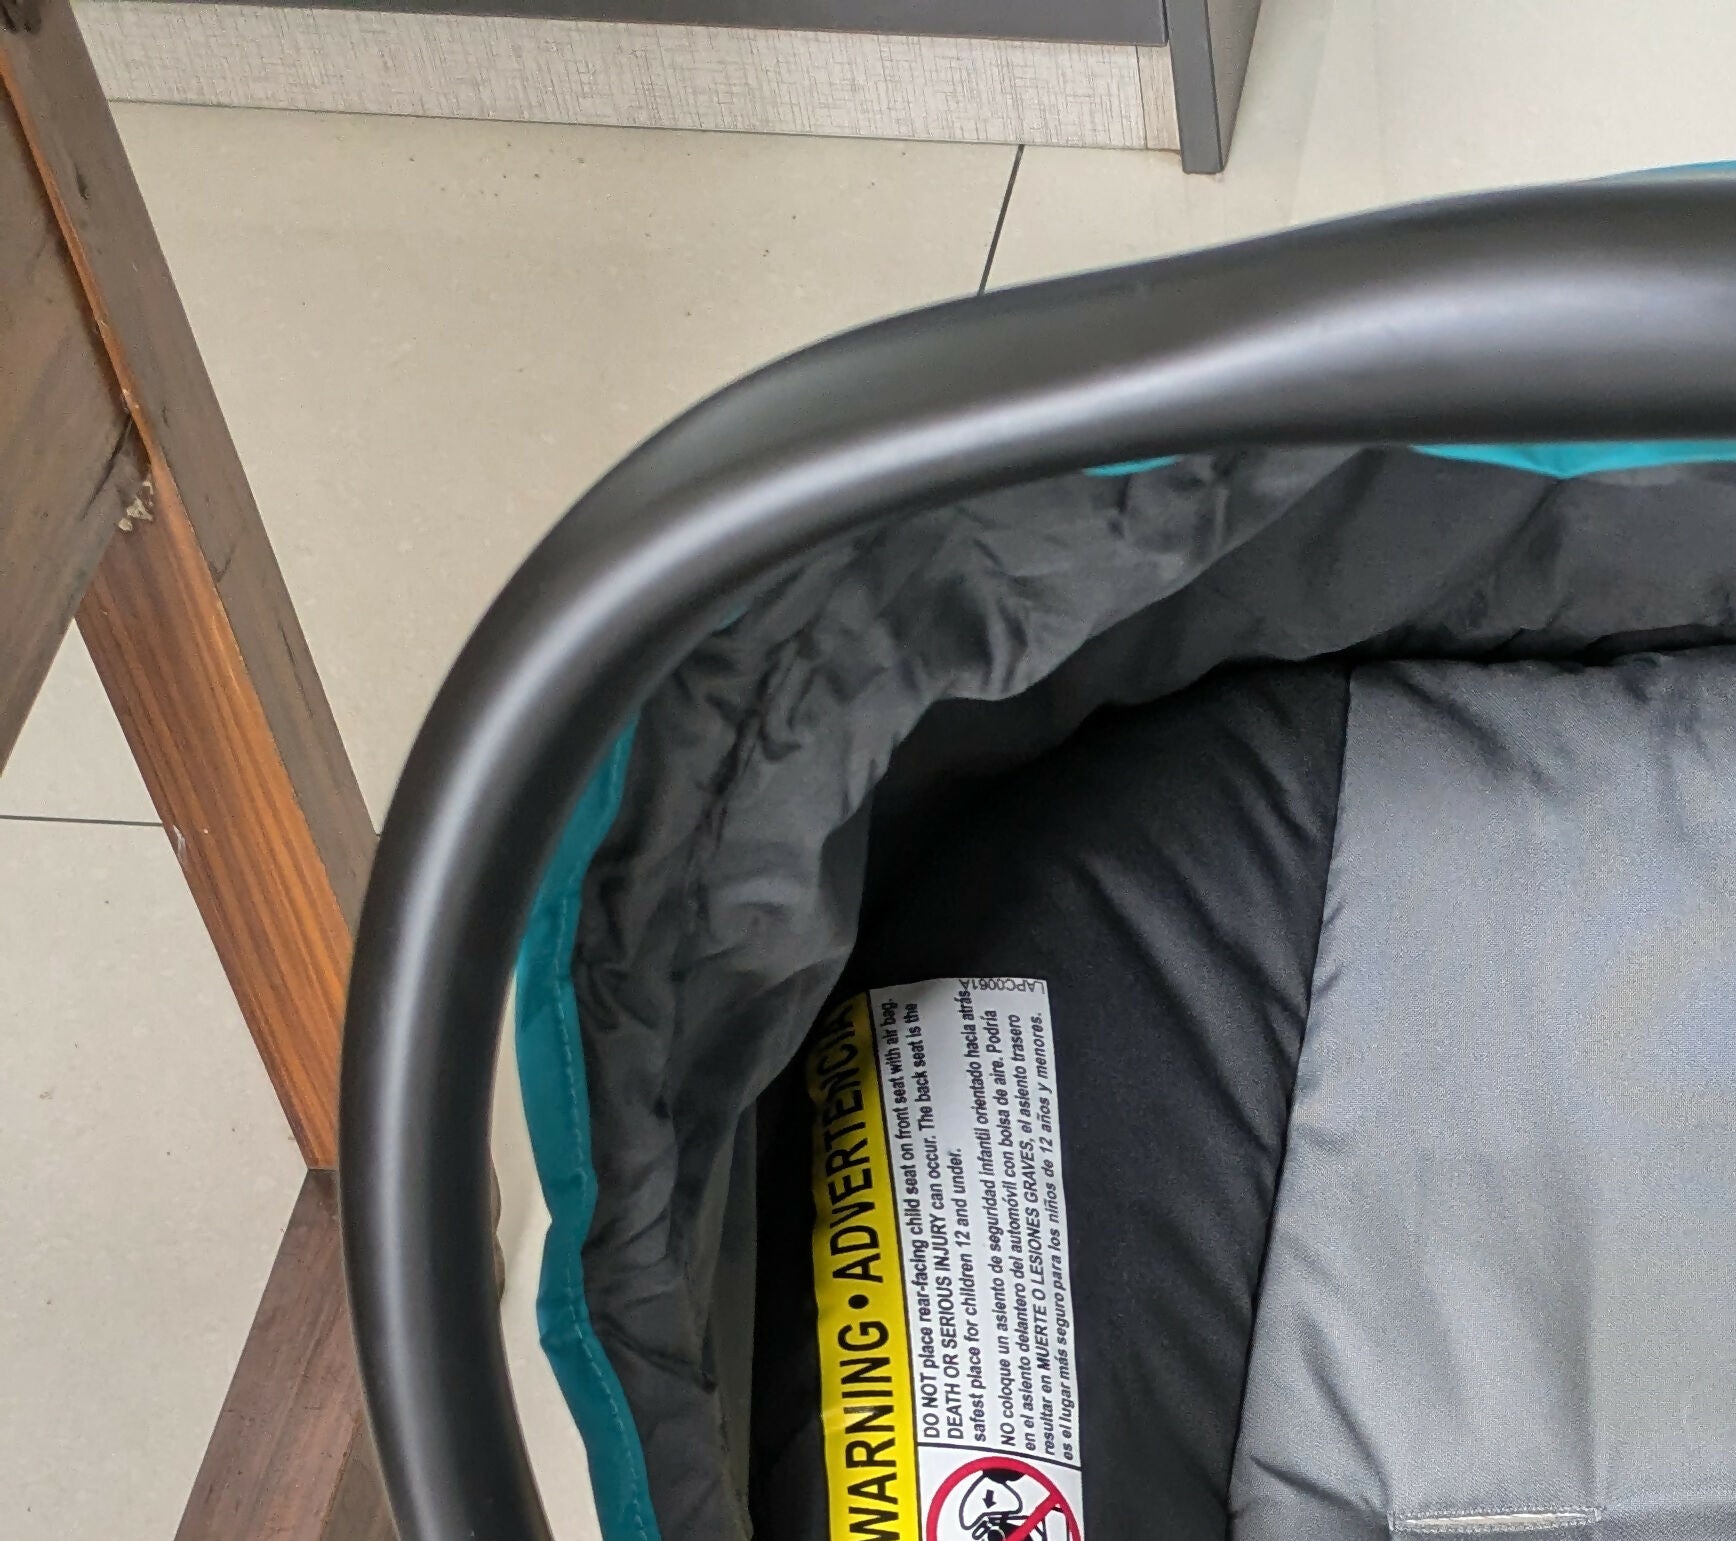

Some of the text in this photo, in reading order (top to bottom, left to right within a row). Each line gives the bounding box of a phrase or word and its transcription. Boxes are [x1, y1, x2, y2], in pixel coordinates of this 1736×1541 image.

[881, 999, 940, 1438] DO NOT place rear-facing child seat on front seat with air bag.
[904, 1003, 963, 1439] DEATH OR SERIOUS INJURY can occur. The back seat is the
[946, 1149, 986, 1442] safest place for children 12 and under.
[954, 990, 1016, 1446] NO coloque un asiento de seguridad infantil orientado hacia atrás
[980, 1010, 1036, 1451] en el asiento delantero del automóvil con bolsa de aire. Podría
[1008, 1014, 1055, 1456] resultar en MUERTE O LESIONES GRAVES, el asiento trasero
[1030, 1012, 1074, 1460] es el lugar más seguro para los niños de 12 años y menores.
